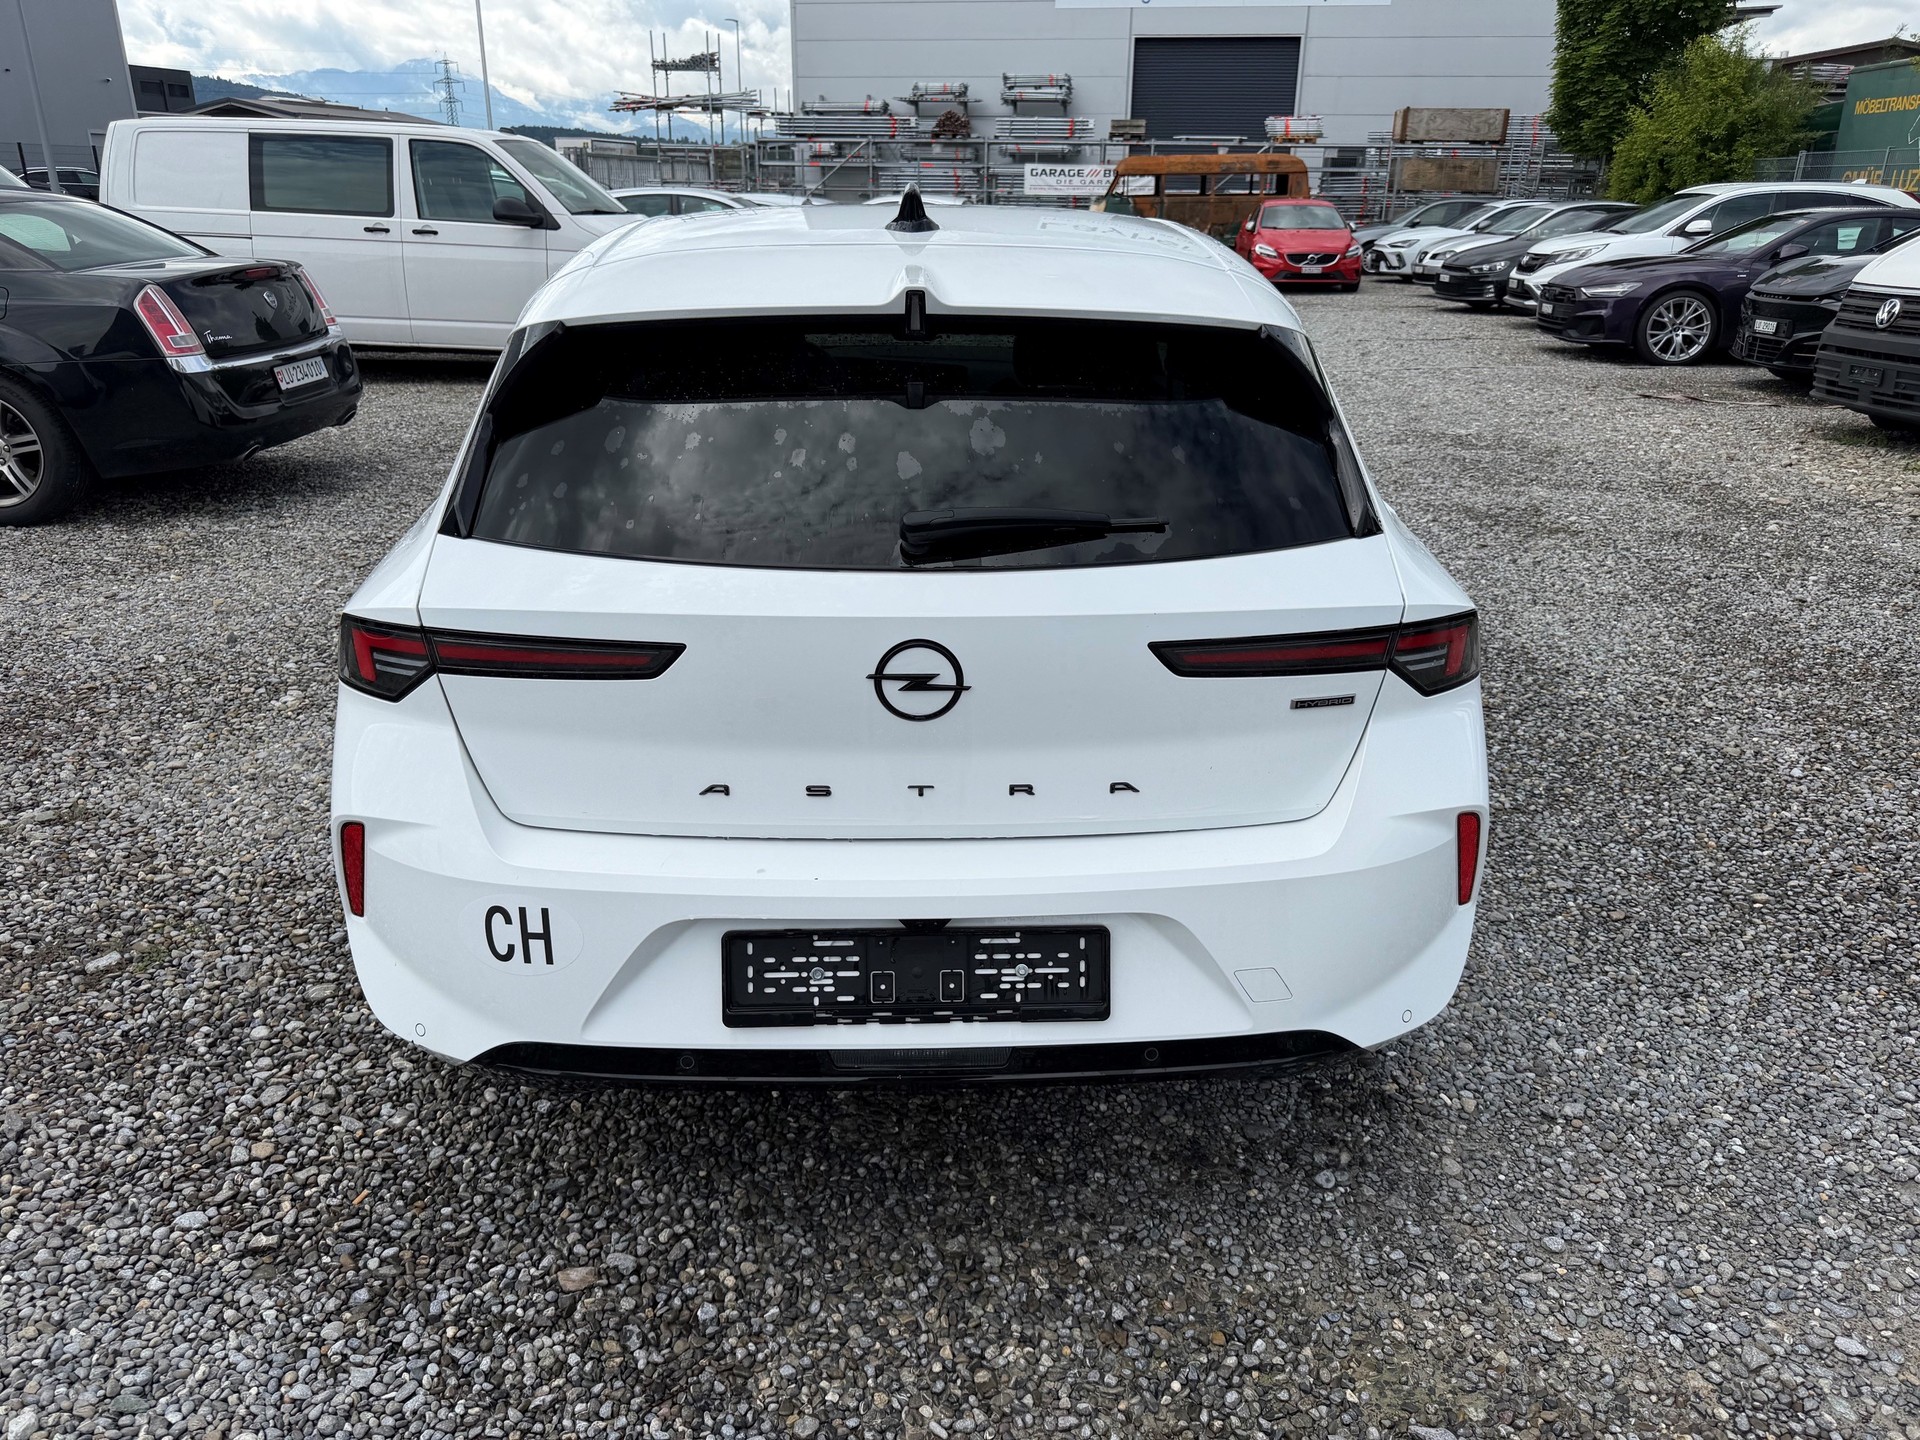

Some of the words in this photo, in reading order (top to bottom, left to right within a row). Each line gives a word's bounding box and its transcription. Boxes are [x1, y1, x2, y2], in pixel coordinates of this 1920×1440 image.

[1030, 168, 1085, 178] GARAGE
[1296, 696, 1353, 709] HYBRID
[699, 782, 1140, 797] ASTRA
[484, 905, 554, 965] CH
